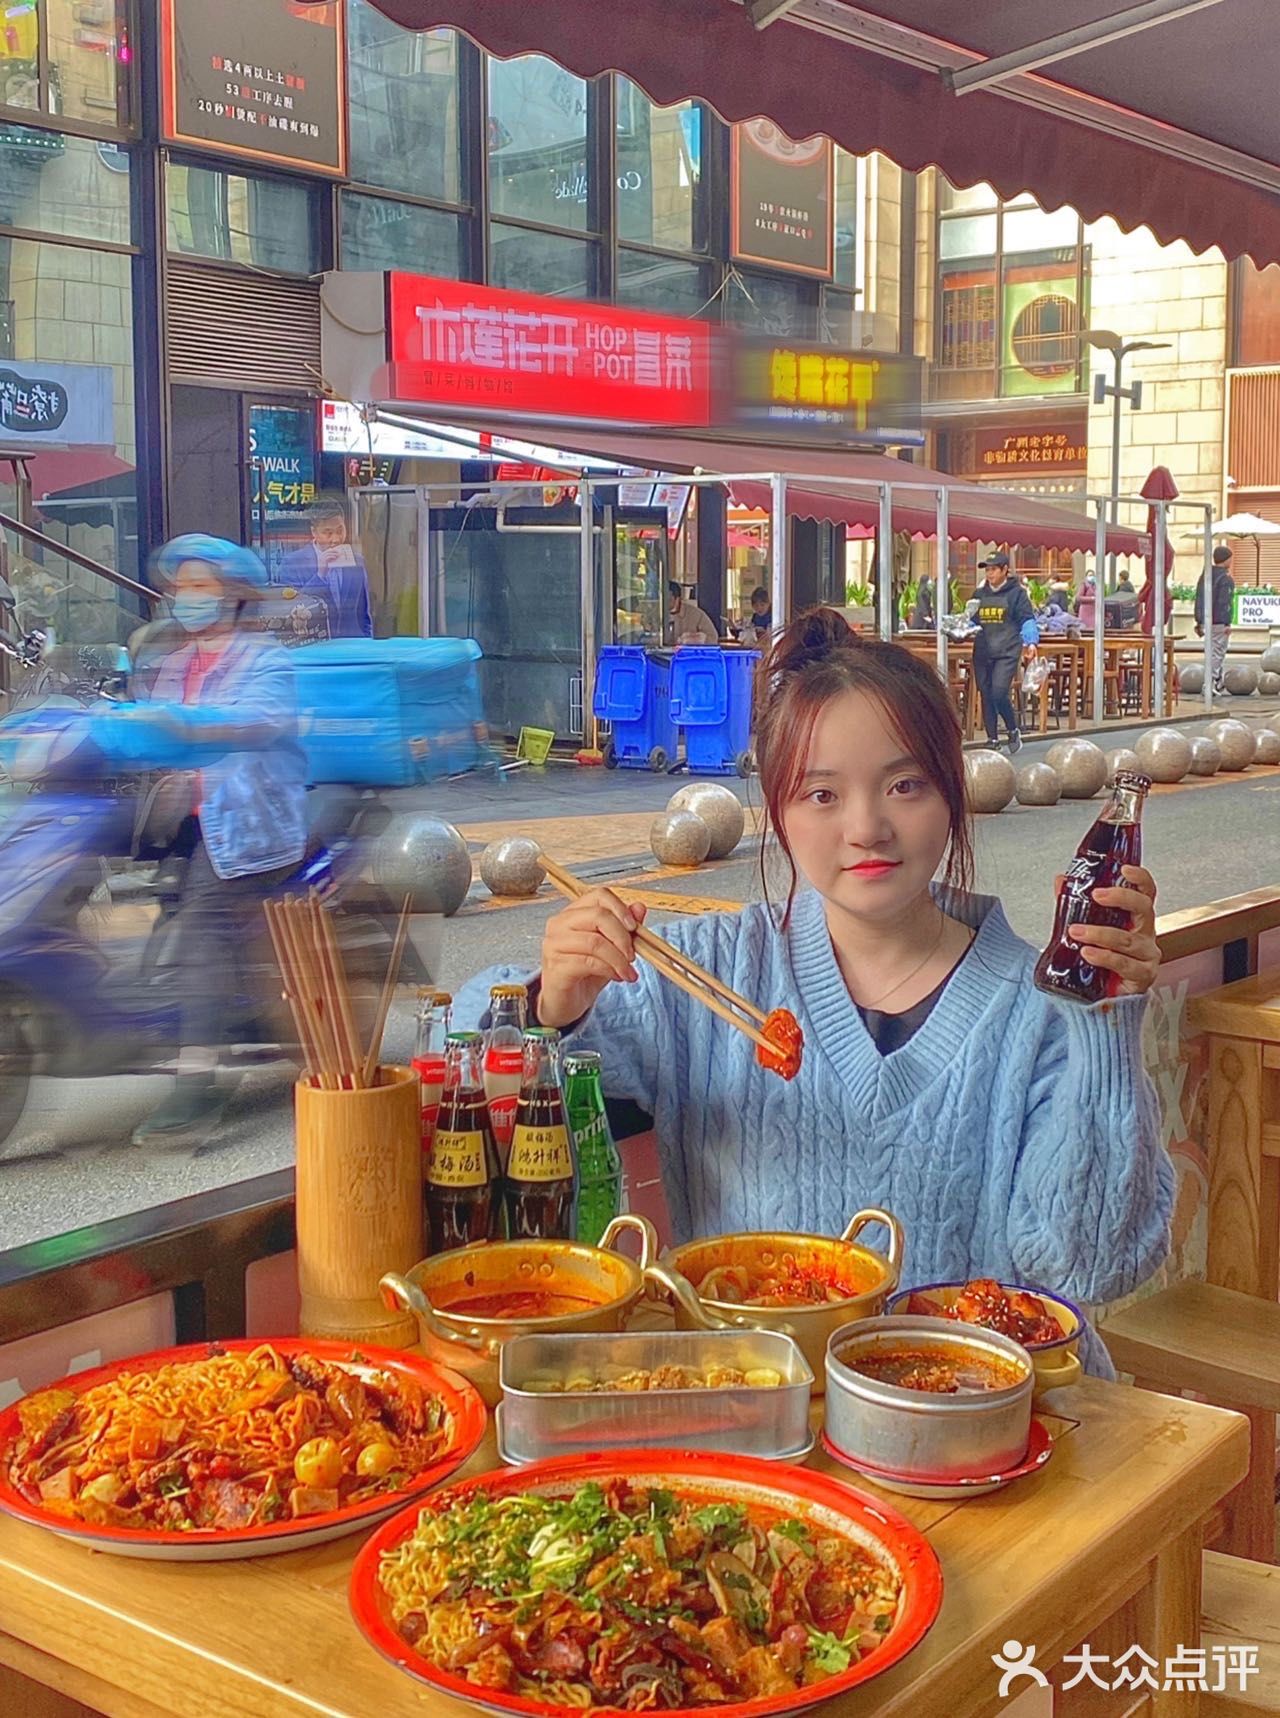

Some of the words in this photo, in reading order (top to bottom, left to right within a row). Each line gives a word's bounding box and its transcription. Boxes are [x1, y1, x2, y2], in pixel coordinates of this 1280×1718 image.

[225, 83, 294, 110] 53工序去腥
[585, 322, 628, 351] HOP
[633, 328, 693, 392] 冒菜
[1004, 434, 1068, 449] 广州老字号
[263, 456, 301, 473] WALK
[1242, 607, 1264, 617] PRO
